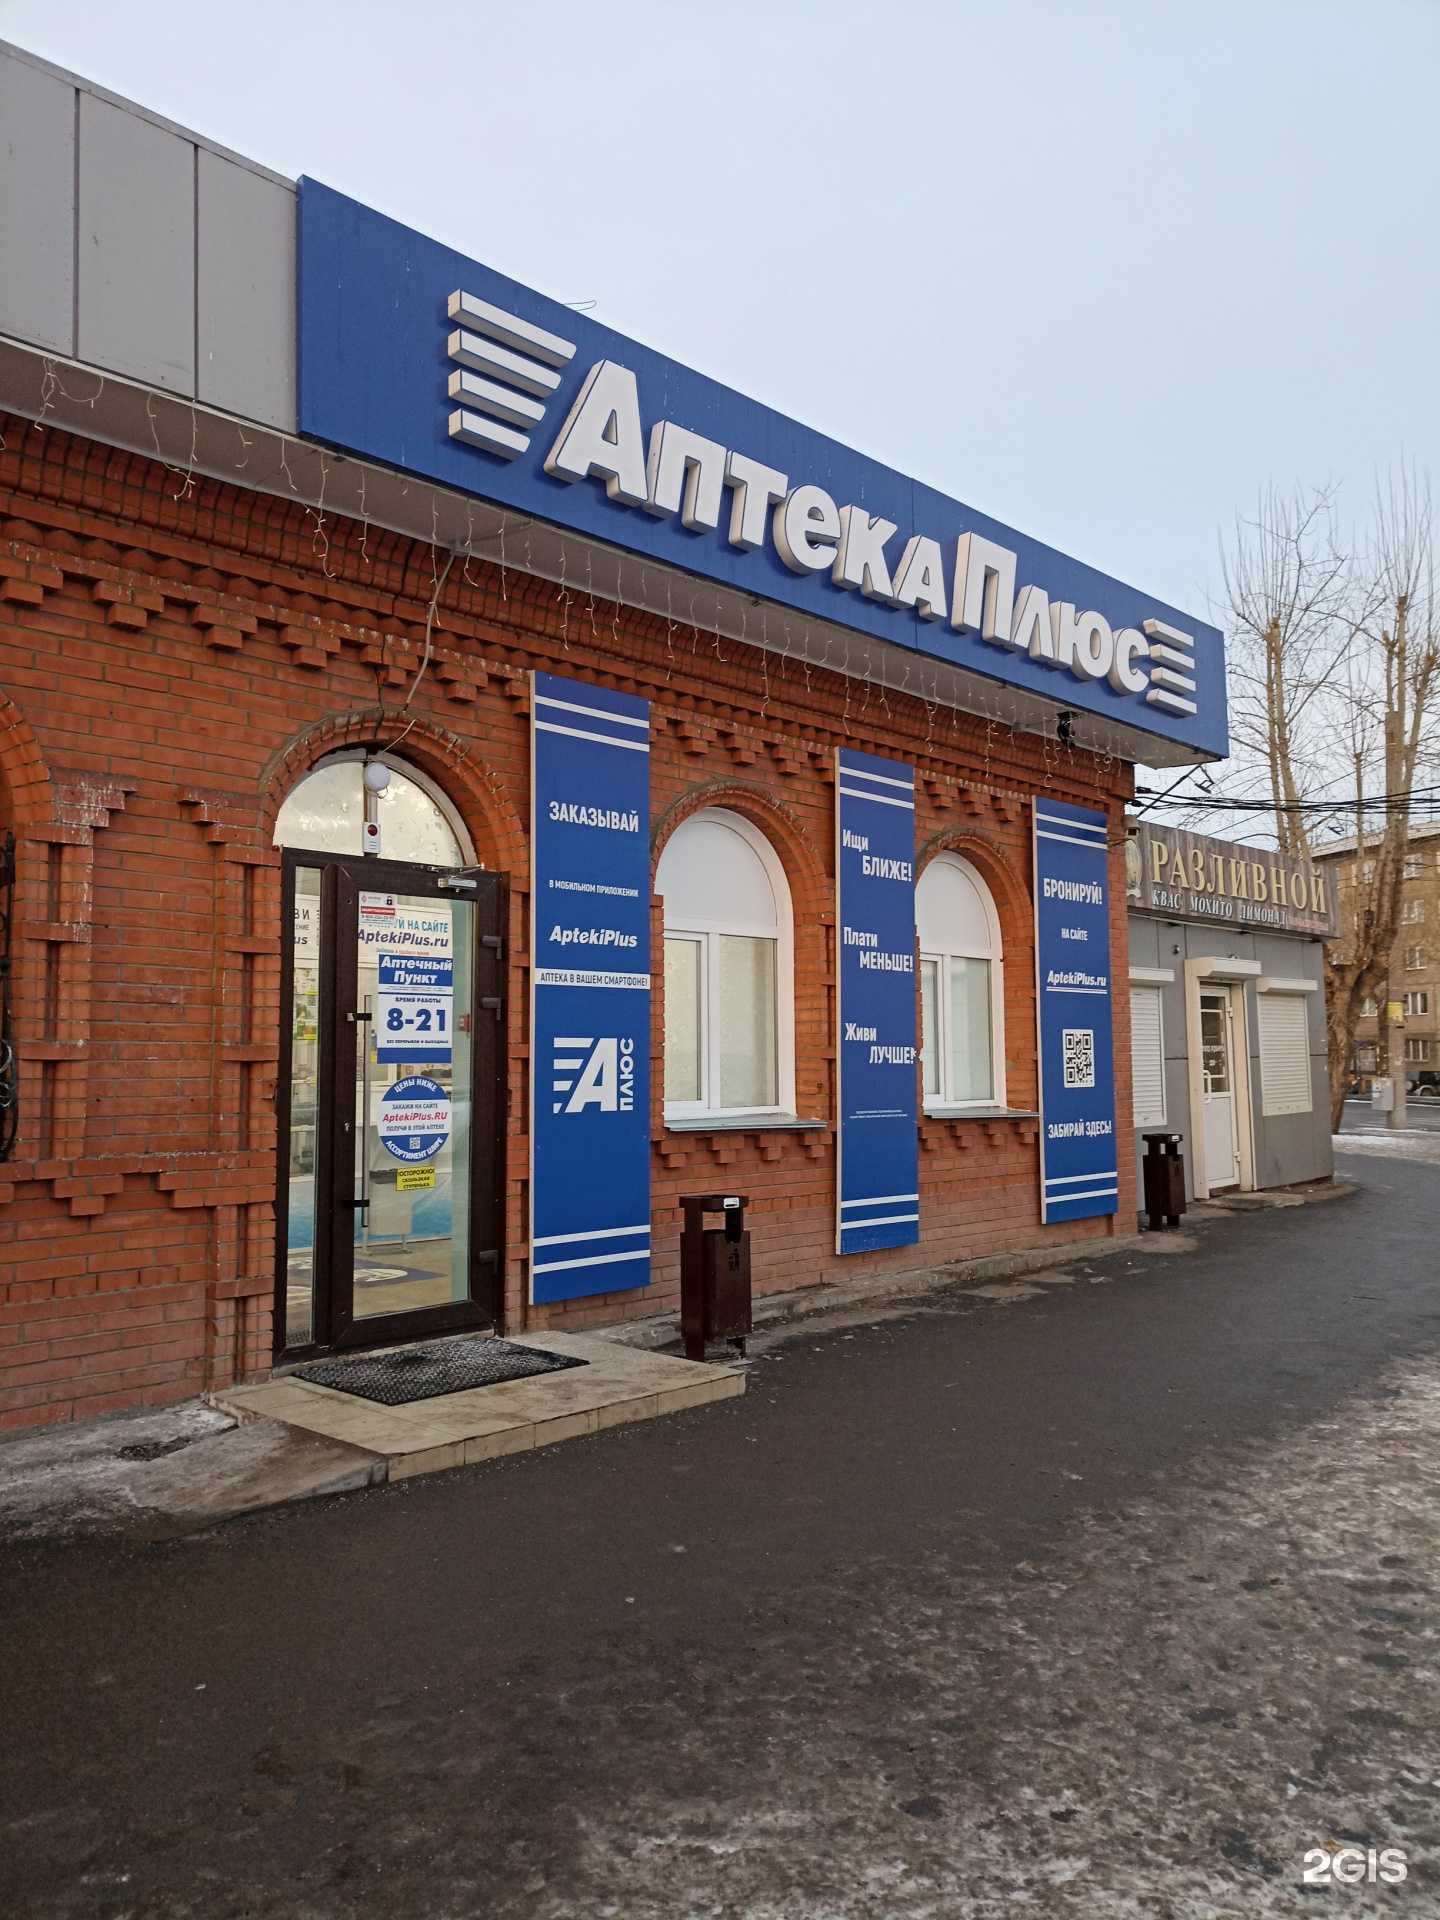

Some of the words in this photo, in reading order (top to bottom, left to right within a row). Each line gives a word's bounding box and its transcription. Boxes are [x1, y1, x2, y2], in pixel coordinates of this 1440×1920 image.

[549, 801, 639, 832] ЗАКАЗЫВАЙ
[842, 829, 869, 852] Ищи
[862, 855, 912, 882] БЛИЖЕ!
[1150, 840, 1328, 914] РАЗЛИВНОЙ
[555, 880, 596, 893] МОБИЛЬНОМ
[1043, 877, 1103, 905] БРОНИРУЙ!
[1152, 890, 1181, 909] КВАС
[1191, 895, 1233, 917] МОХИТО
[1240, 901, 1287, 929] ЛИМОНАД
[407, 919, 419, 930] НА
[421, 920, 448, 933] САЙТЕ
[1061, 927, 1070, 939] НА
[1070, 927, 1088, 941] САЙТЕ
[357, 929, 448, 947] AptekiPlus.ru
[549, 925, 638, 948] AptekiPlus
[843, 926, 878, 947] Плати
[381, 955, 453, 971] Аптечный
[859, 950, 914, 972] МЕНЬШЕ!
[394, 970, 437, 985] Пункт
[540, 972, 568, 983] АПТЕКА
[577, 974, 603, 985] ВАШЕМ
[604, 976, 648, 987] СМАРТФОНЕ!
[1047, 970, 1107, 986] AptekiPlus.ru
[386, 1007, 446, 1032] 8-21
[845, 1022, 877, 1042] Живи
[869, 1046, 914, 1064] ЛУЧШЕ!
[393, 1078, 415, 1093] ЦЕНЫ
[1048, 1119, 1085, 1138] ЗАБИРАЙ
[1085, 1120, 1112, 1137] ЗДЕСЬ!
